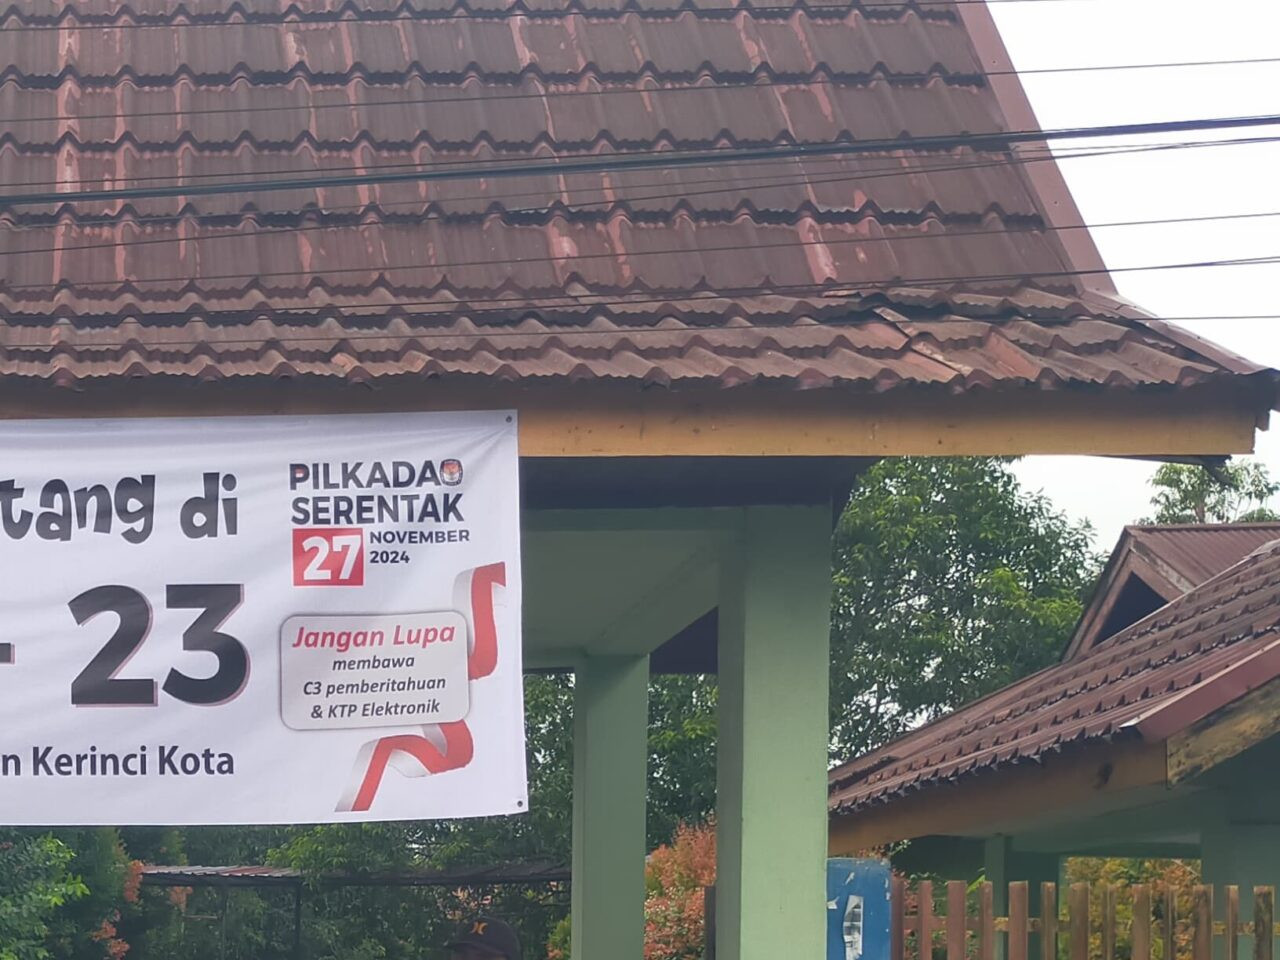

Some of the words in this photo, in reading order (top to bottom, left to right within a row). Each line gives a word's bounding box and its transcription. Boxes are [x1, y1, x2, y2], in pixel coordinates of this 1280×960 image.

[289, 460, 441, 490] PILKADA
[180, 471, 239, 540] di
[291, 493, 465, 525] SERENTAK
[370, 530, 470, 544] NOVEMBER
[302, 535, 362, 580] 27
[370, 551, 410, 564] 2024
[67, 583, 251, 706] 23
[292, 627, 384, 652] Jangan
[393, 625, 455, 648] Lupa
[332, 655, 415, 671] membawa
[303, 682, 321, 695] C3
[326, 677, 446, 698] pemberitahuan
[311, 705, 323, 719] &
[328, 704, 357, 718] KTP
[362, 699, 440, 716] Elektronik
[32, 744, 148, 778] Kerinci
[158, 745, 235, 777] Kota
